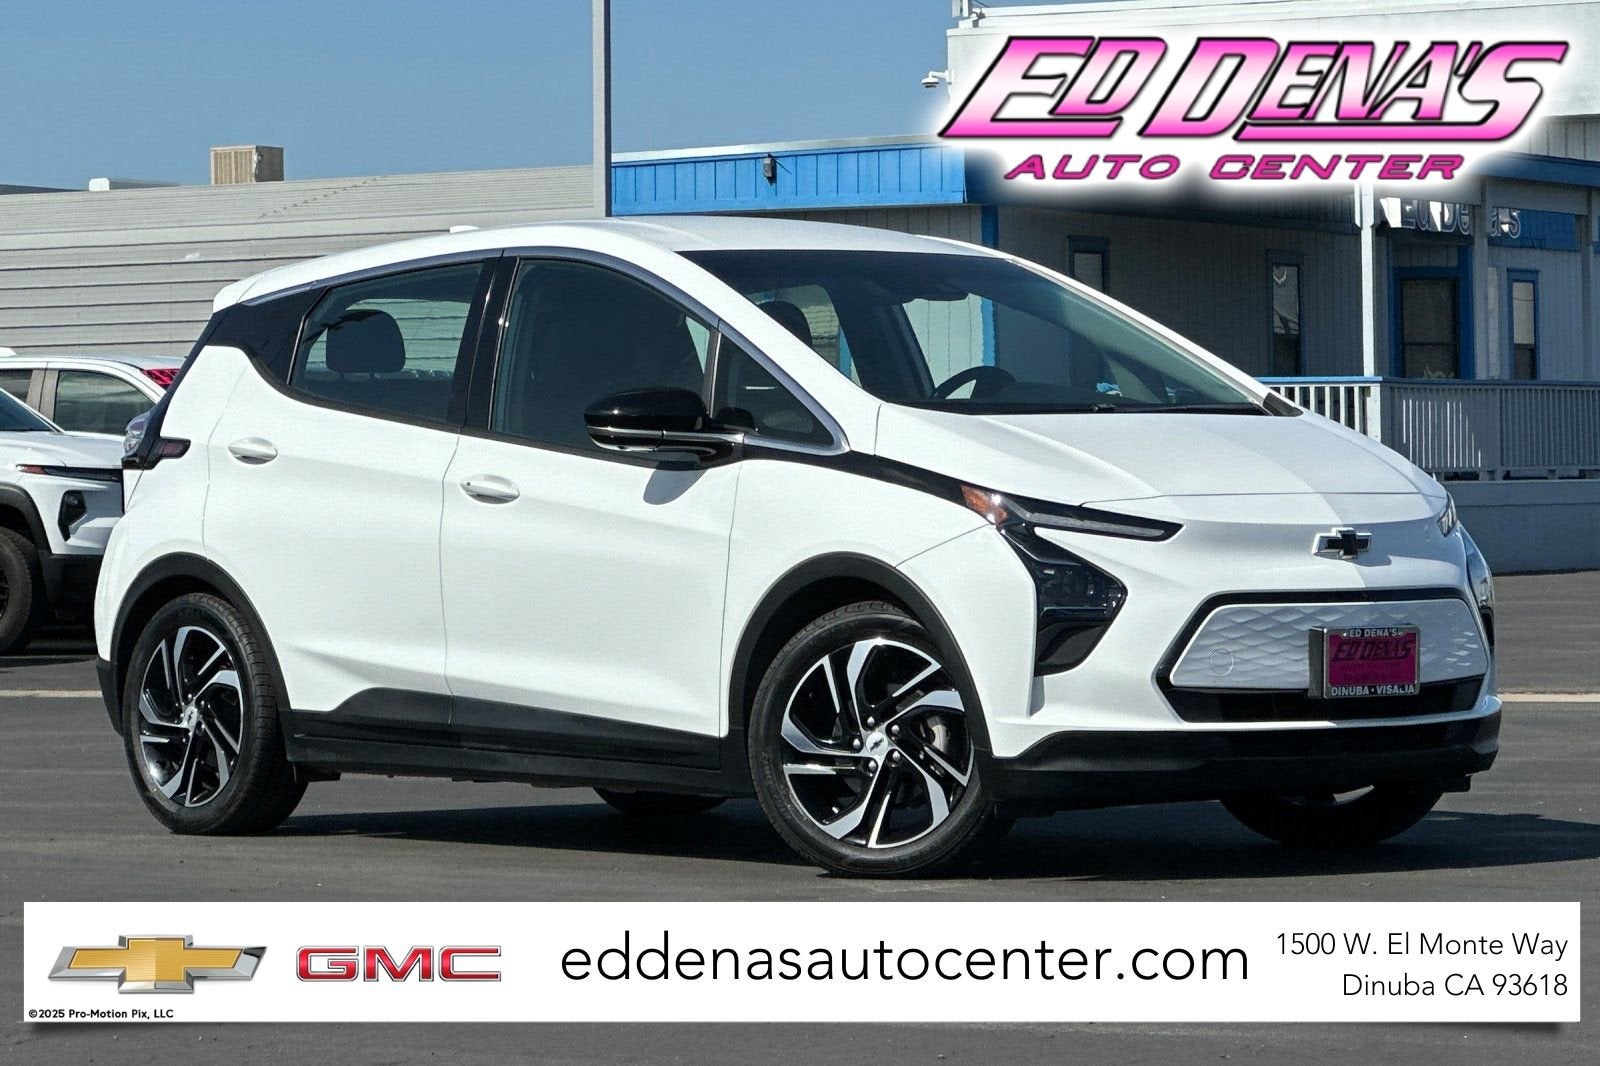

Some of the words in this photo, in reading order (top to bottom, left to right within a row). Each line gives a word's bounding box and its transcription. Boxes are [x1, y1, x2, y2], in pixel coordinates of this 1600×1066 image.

[1350, 629, 1362, 638] ED
[1364, 628, 1397, 637] DENA'S
[1331, 686, 1370, 696] DINUBA
[1375, 684, 1415, 695] VISALIA
